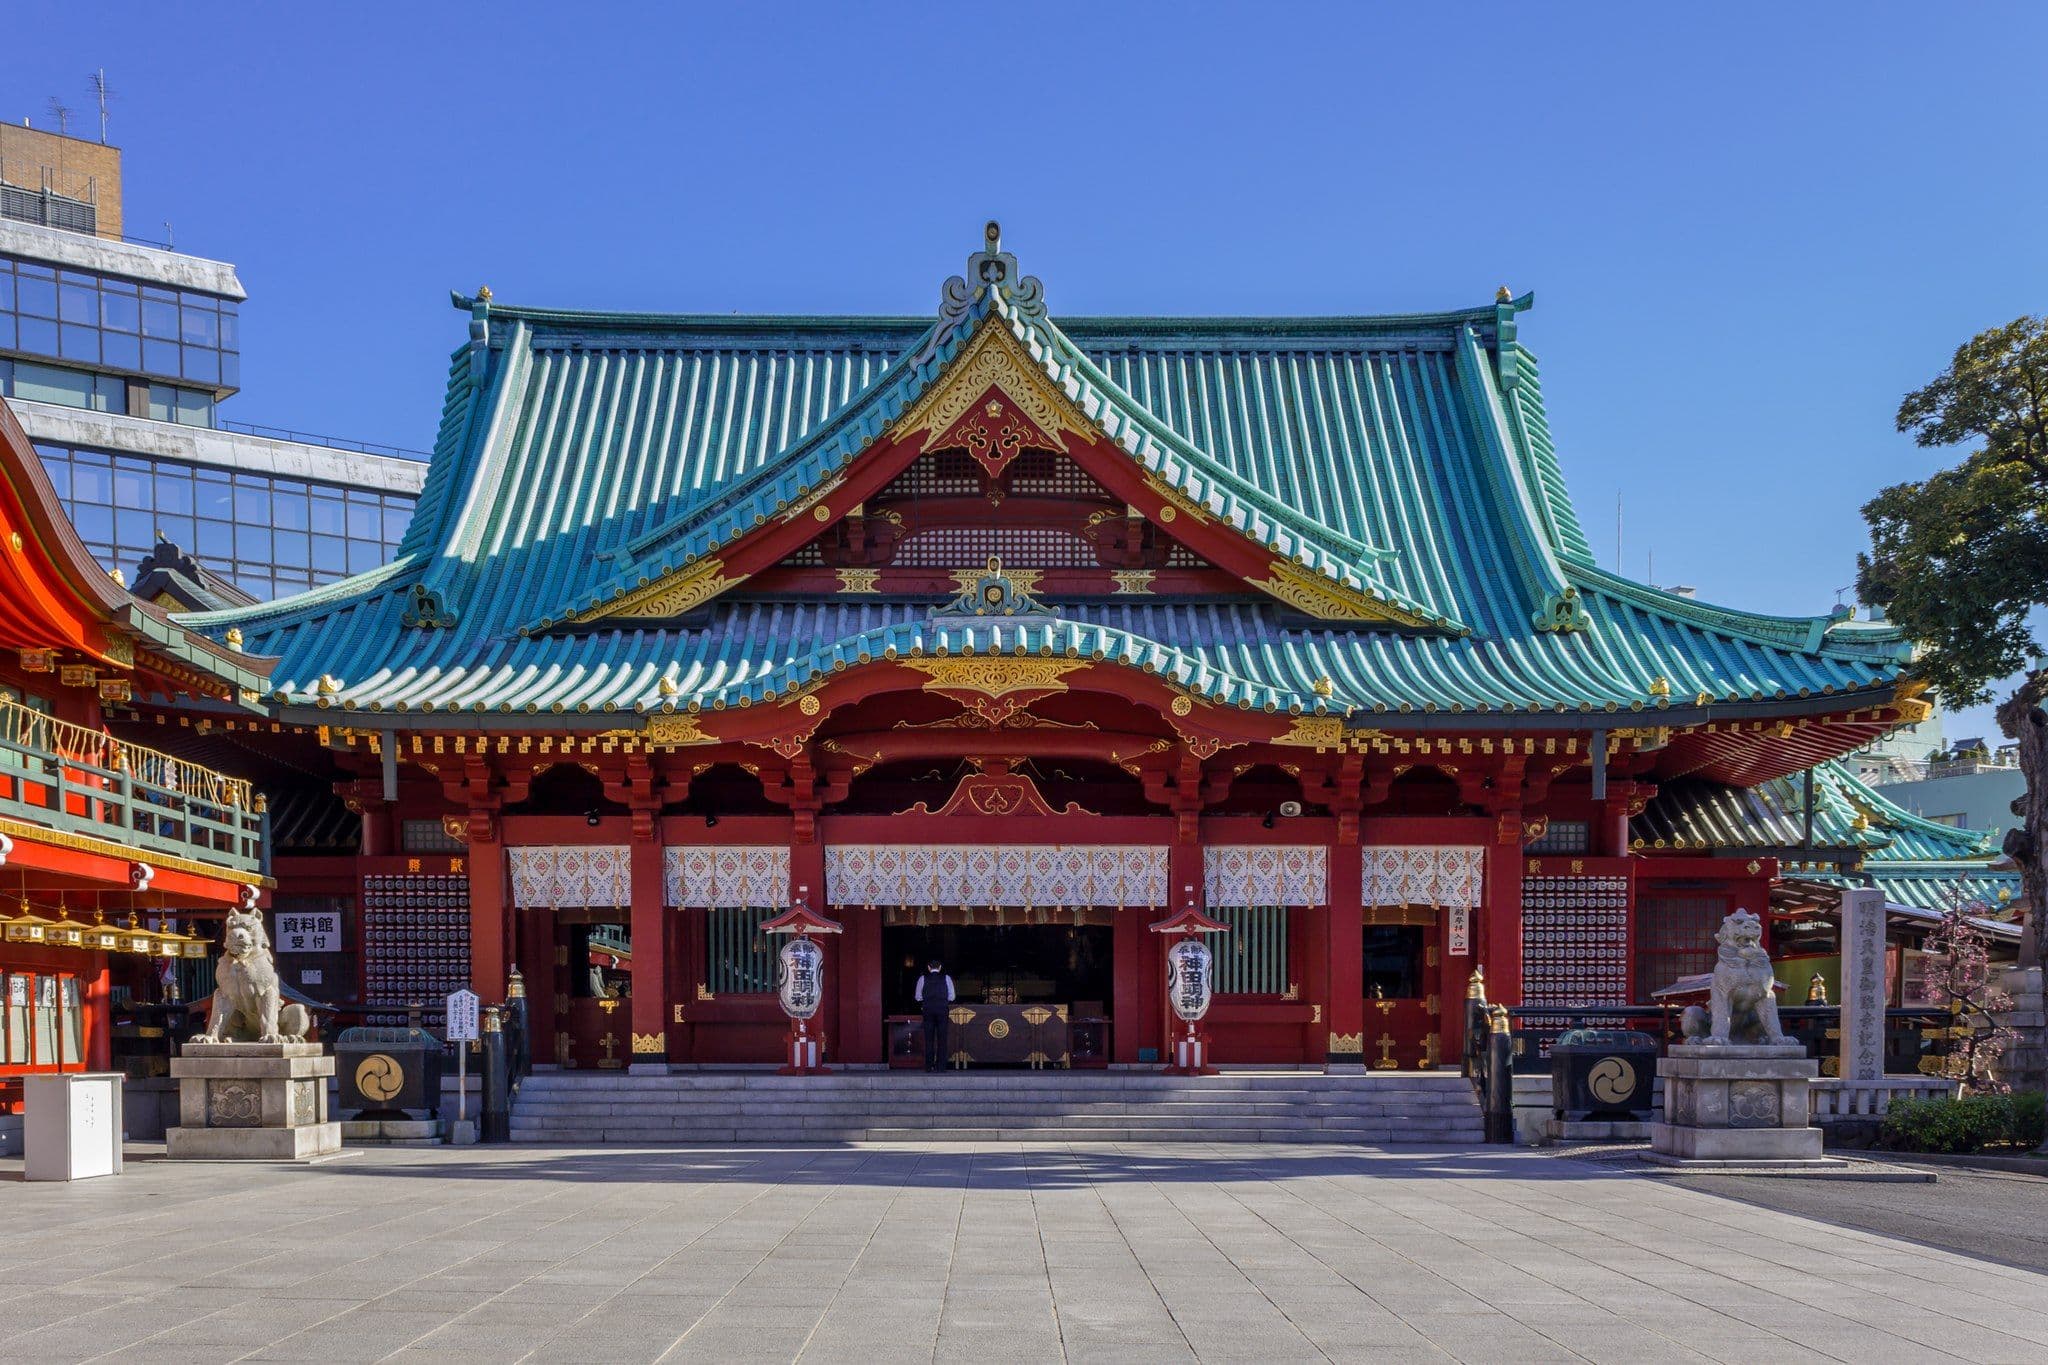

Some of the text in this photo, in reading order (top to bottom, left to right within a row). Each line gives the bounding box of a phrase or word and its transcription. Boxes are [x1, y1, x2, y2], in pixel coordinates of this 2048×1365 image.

[283, 917, 333, 932] 資料館
[291, 936, 326, 948] 受付
[791, 954, 814, 1007] 神田明神
[1180, 955, 1203, 1009] 神田明神
